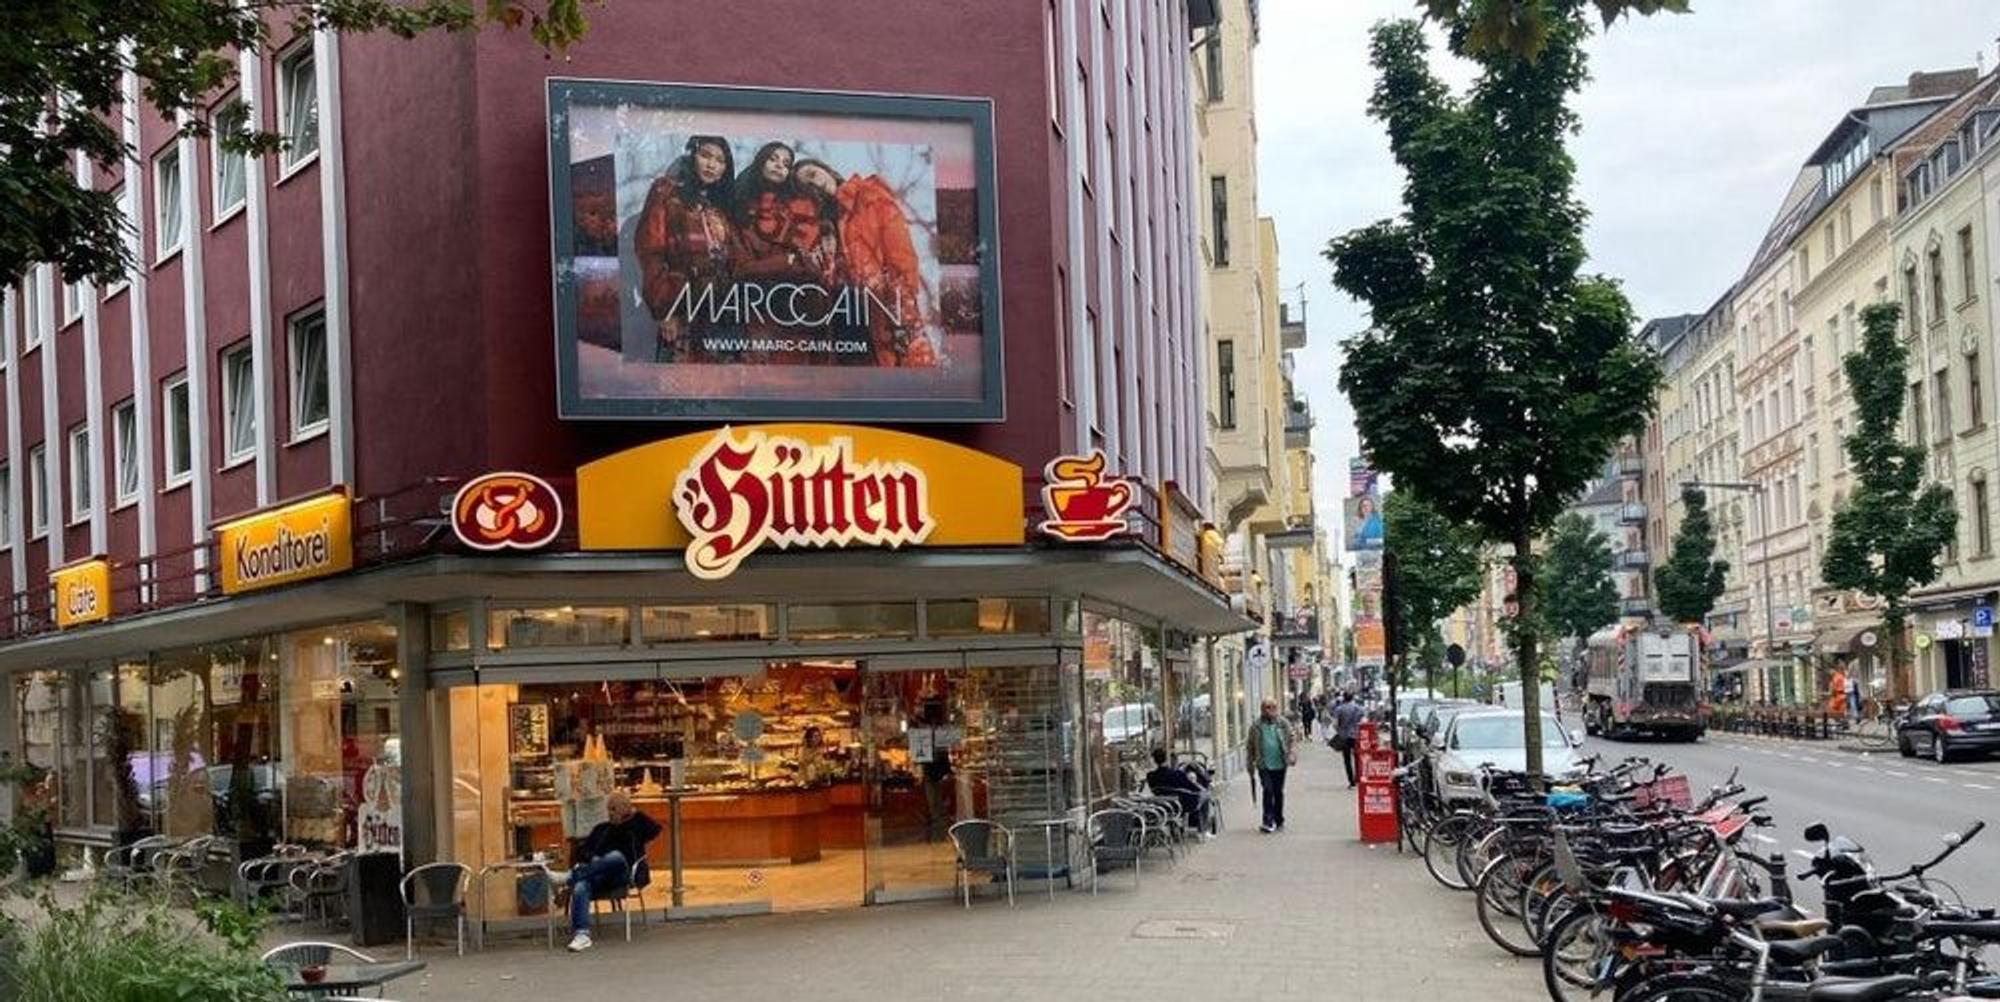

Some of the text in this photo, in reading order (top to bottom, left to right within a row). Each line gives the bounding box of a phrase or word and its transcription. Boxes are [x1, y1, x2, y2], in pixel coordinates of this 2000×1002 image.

[703, 338, 868, 353] WWW.MARC-CAIN.COM
[682, 440, 926, 571] Hütten
[235, 518, 331, 581] Konditorei
